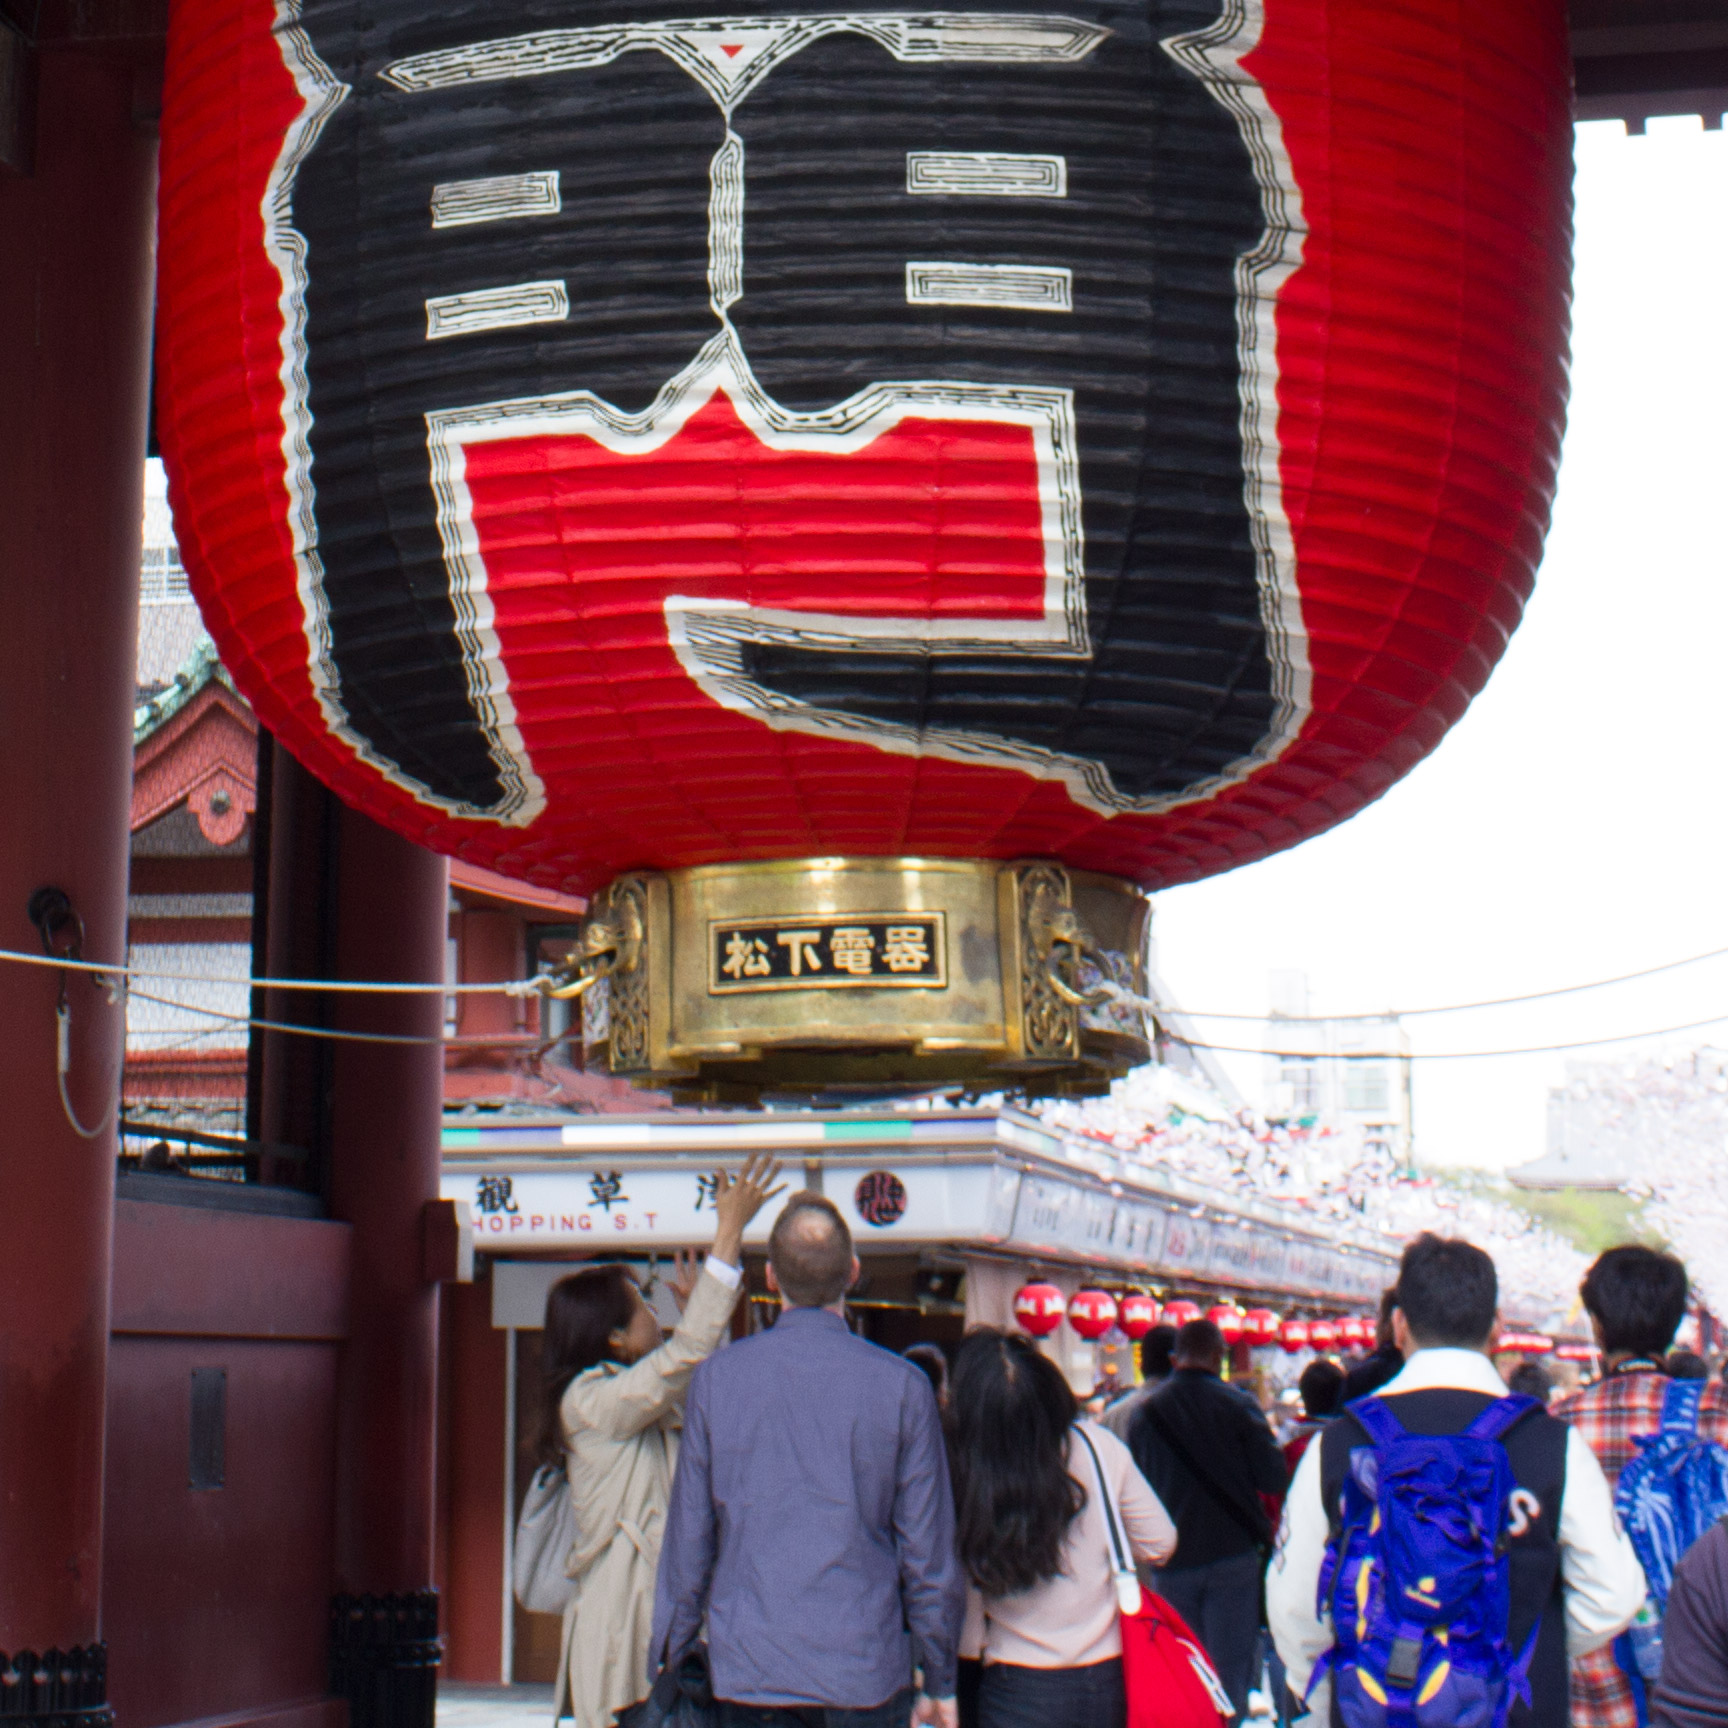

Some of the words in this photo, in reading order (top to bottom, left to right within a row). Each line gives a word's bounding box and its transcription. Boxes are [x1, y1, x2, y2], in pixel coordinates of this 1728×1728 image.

[722, 926, 932, 979] 松下電器
[471, 1214, 593, 1233] HOPPING
